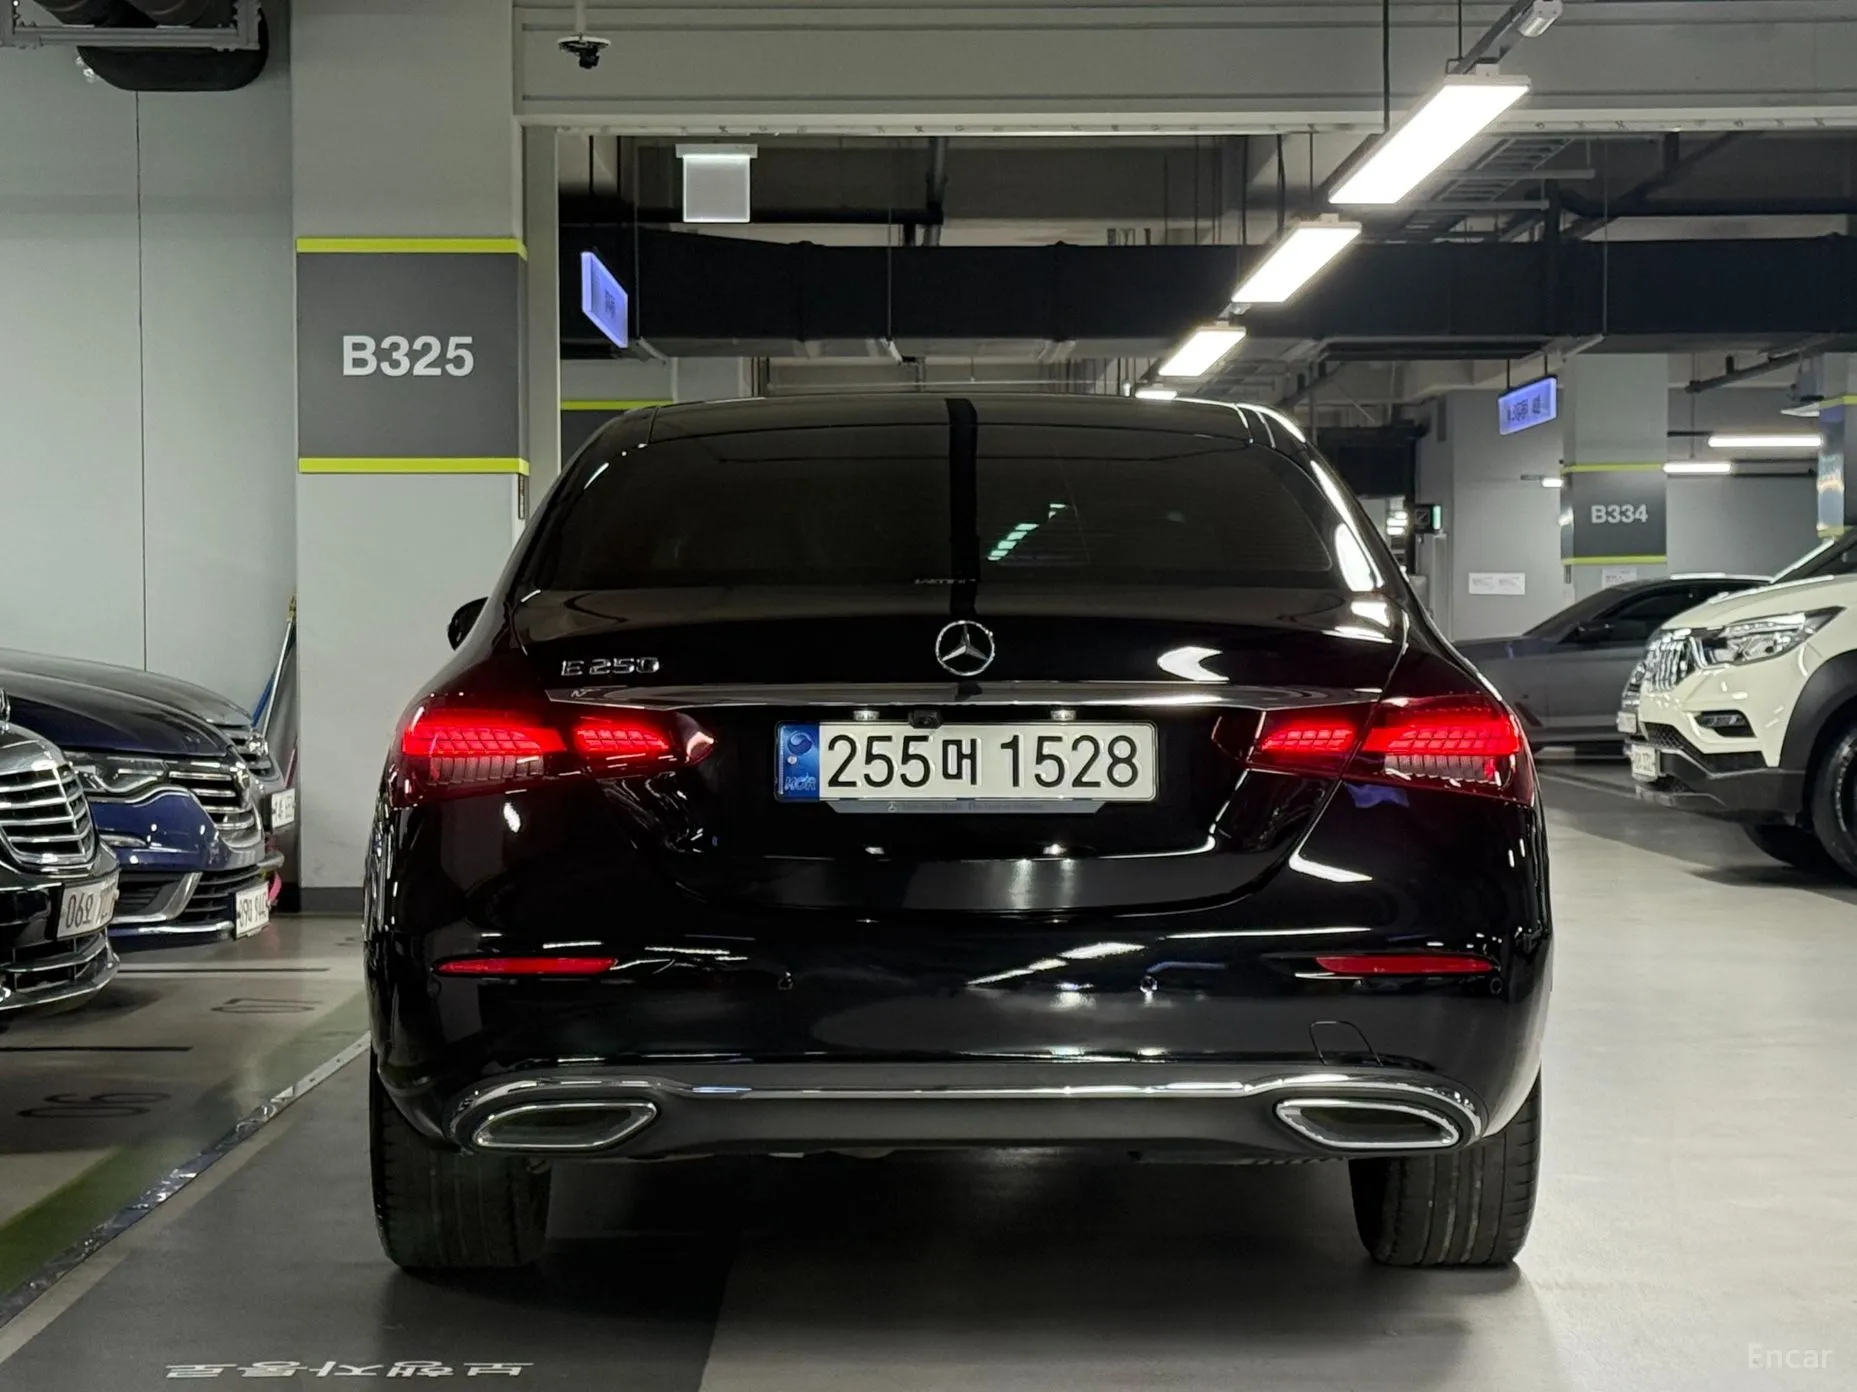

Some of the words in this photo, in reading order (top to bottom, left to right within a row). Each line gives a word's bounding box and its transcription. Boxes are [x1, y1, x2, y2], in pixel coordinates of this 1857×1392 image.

[342, 335, 474, 377] B325
[1591, 503, 1648, 524] B334
[560, 660, 585, 676] E
[592, 657, 660, 675] 250
[827, 734, 978, 788] 255머
[1000, 734, 1139, 788] 1528
[165, 1360, 534, 1379] 보행자통로
